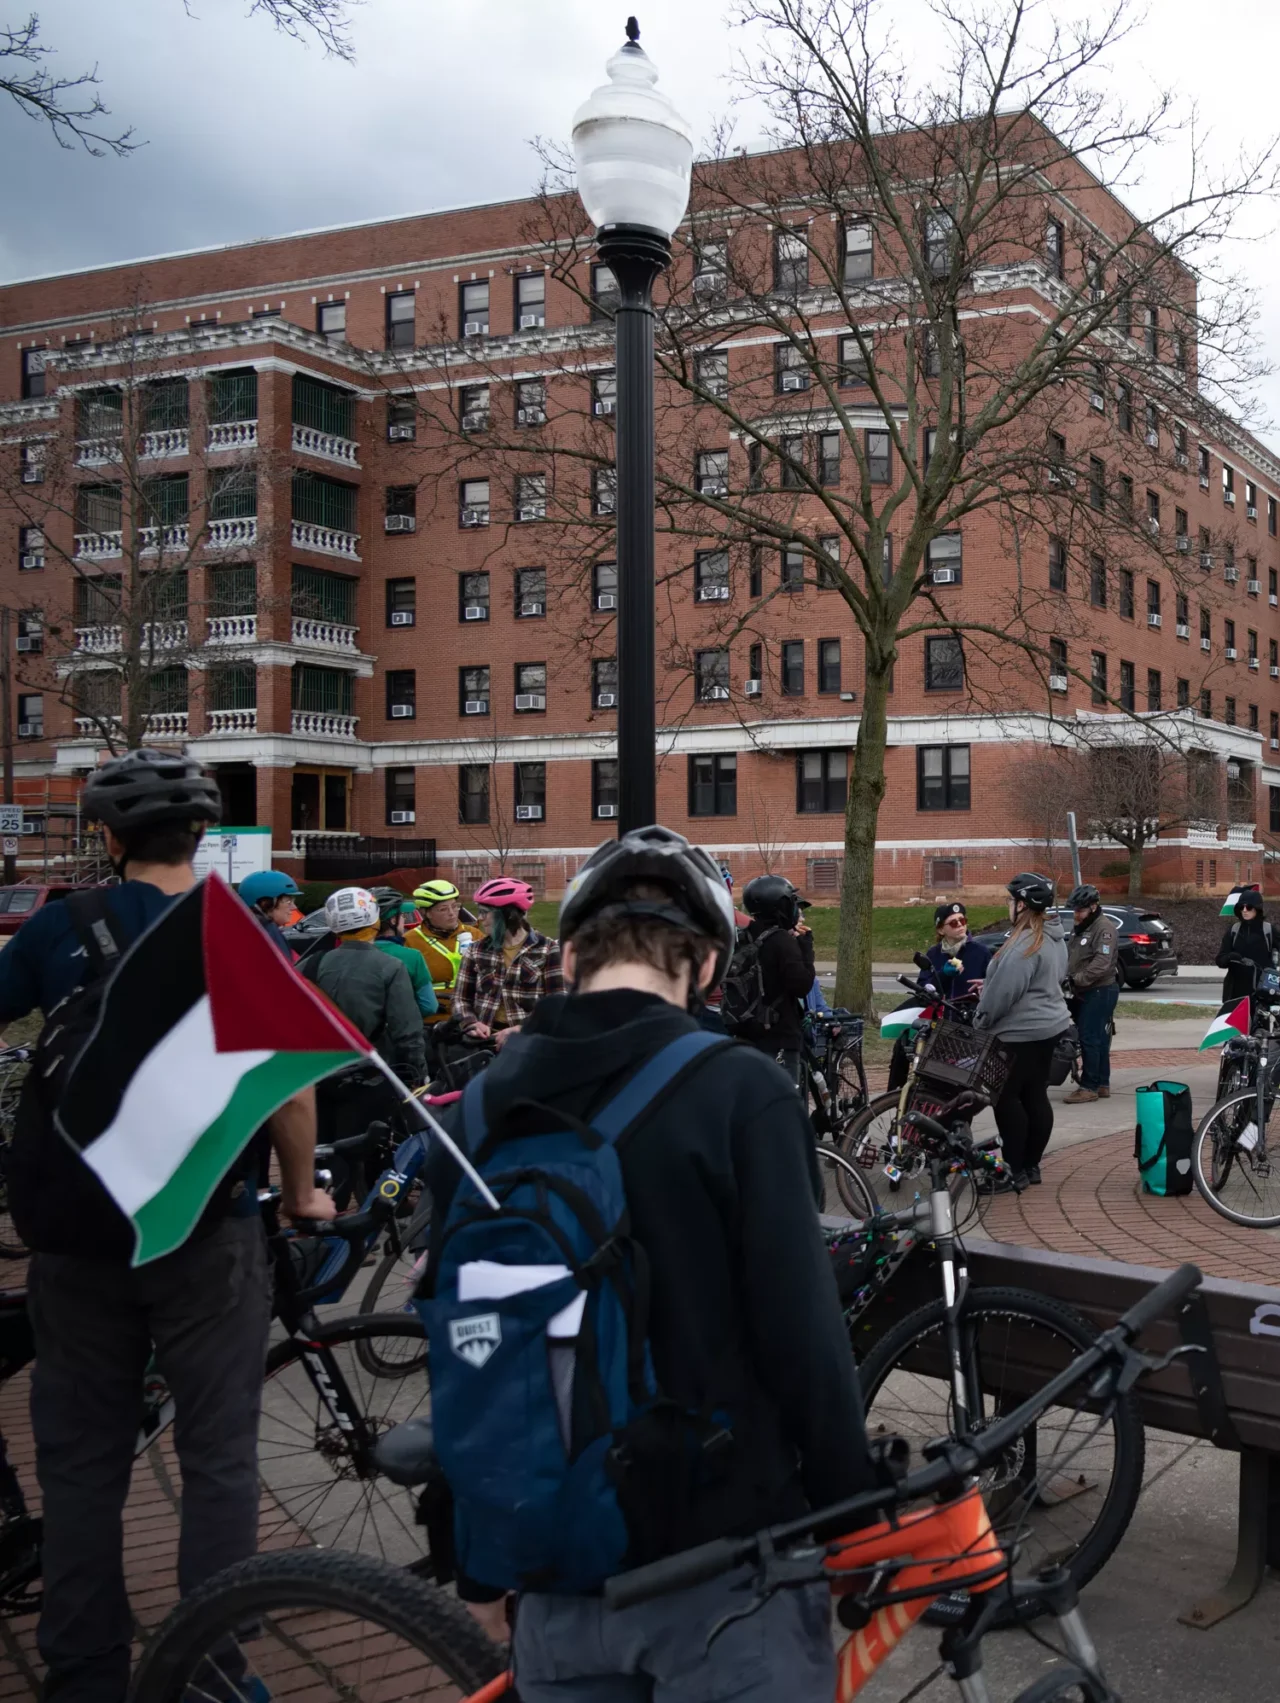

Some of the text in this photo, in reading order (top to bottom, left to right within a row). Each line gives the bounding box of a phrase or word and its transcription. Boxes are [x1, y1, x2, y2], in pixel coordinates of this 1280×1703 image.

[1, 819, 20, 831] 25
[303, 1351, 355, 1431] FUJI
[930, 1601, 967, 1616] BONTR
